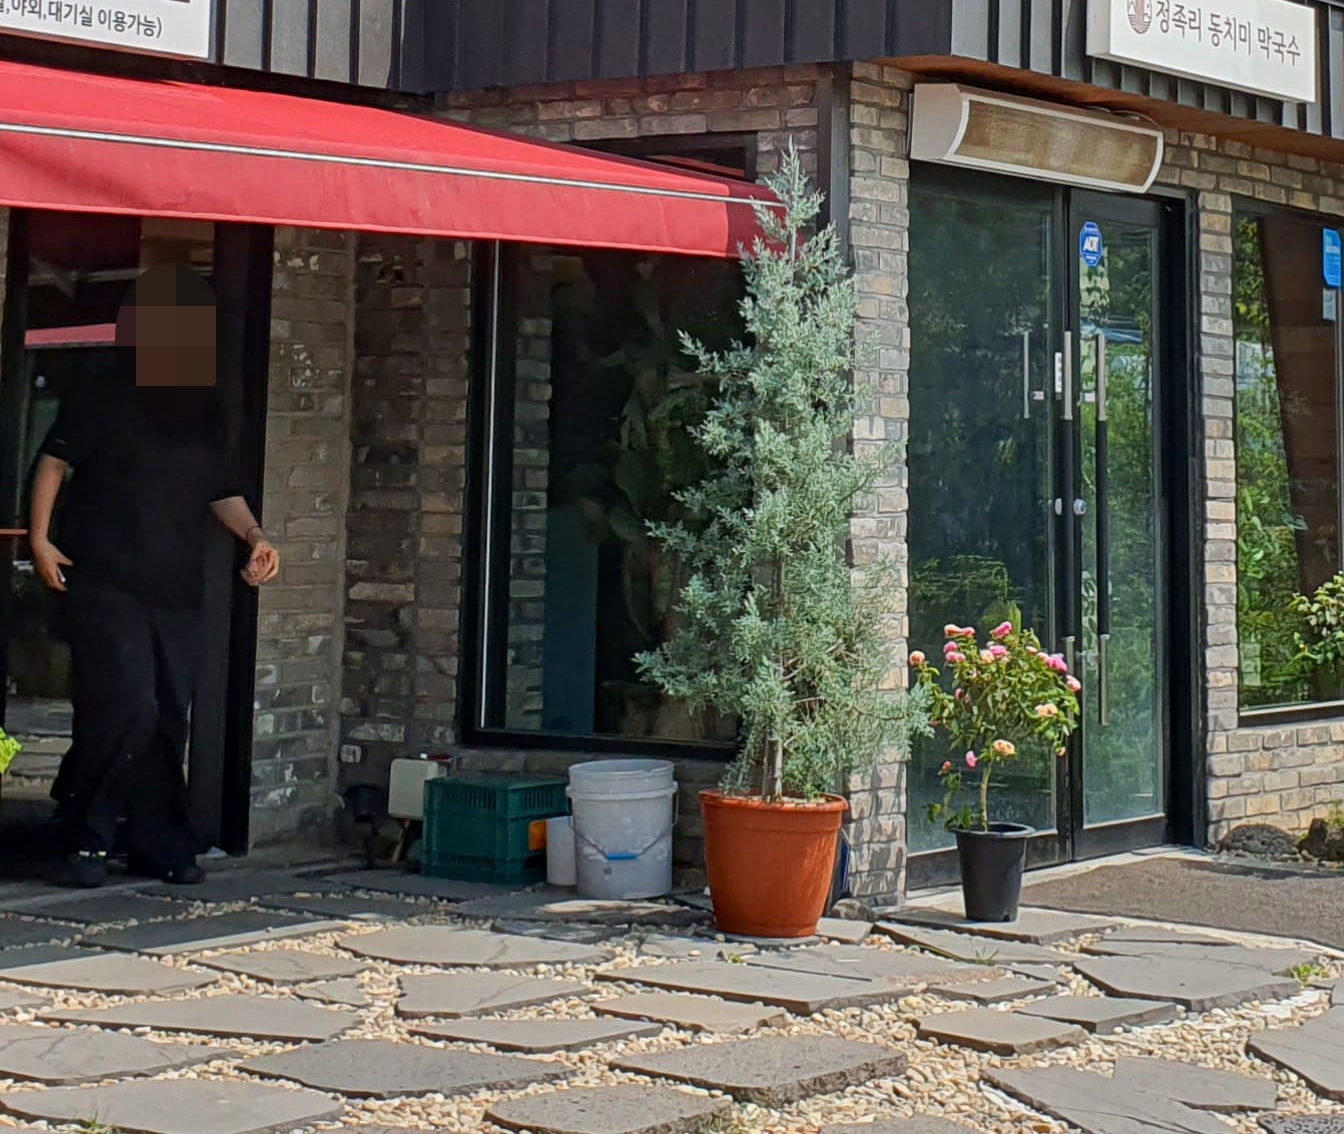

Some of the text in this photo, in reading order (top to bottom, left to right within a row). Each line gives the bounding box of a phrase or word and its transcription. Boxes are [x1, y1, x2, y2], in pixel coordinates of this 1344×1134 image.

[98, 9, 162, 39] 이용가능)
[1156, 0, 1301, 66] 정족리 동치미 막국수
